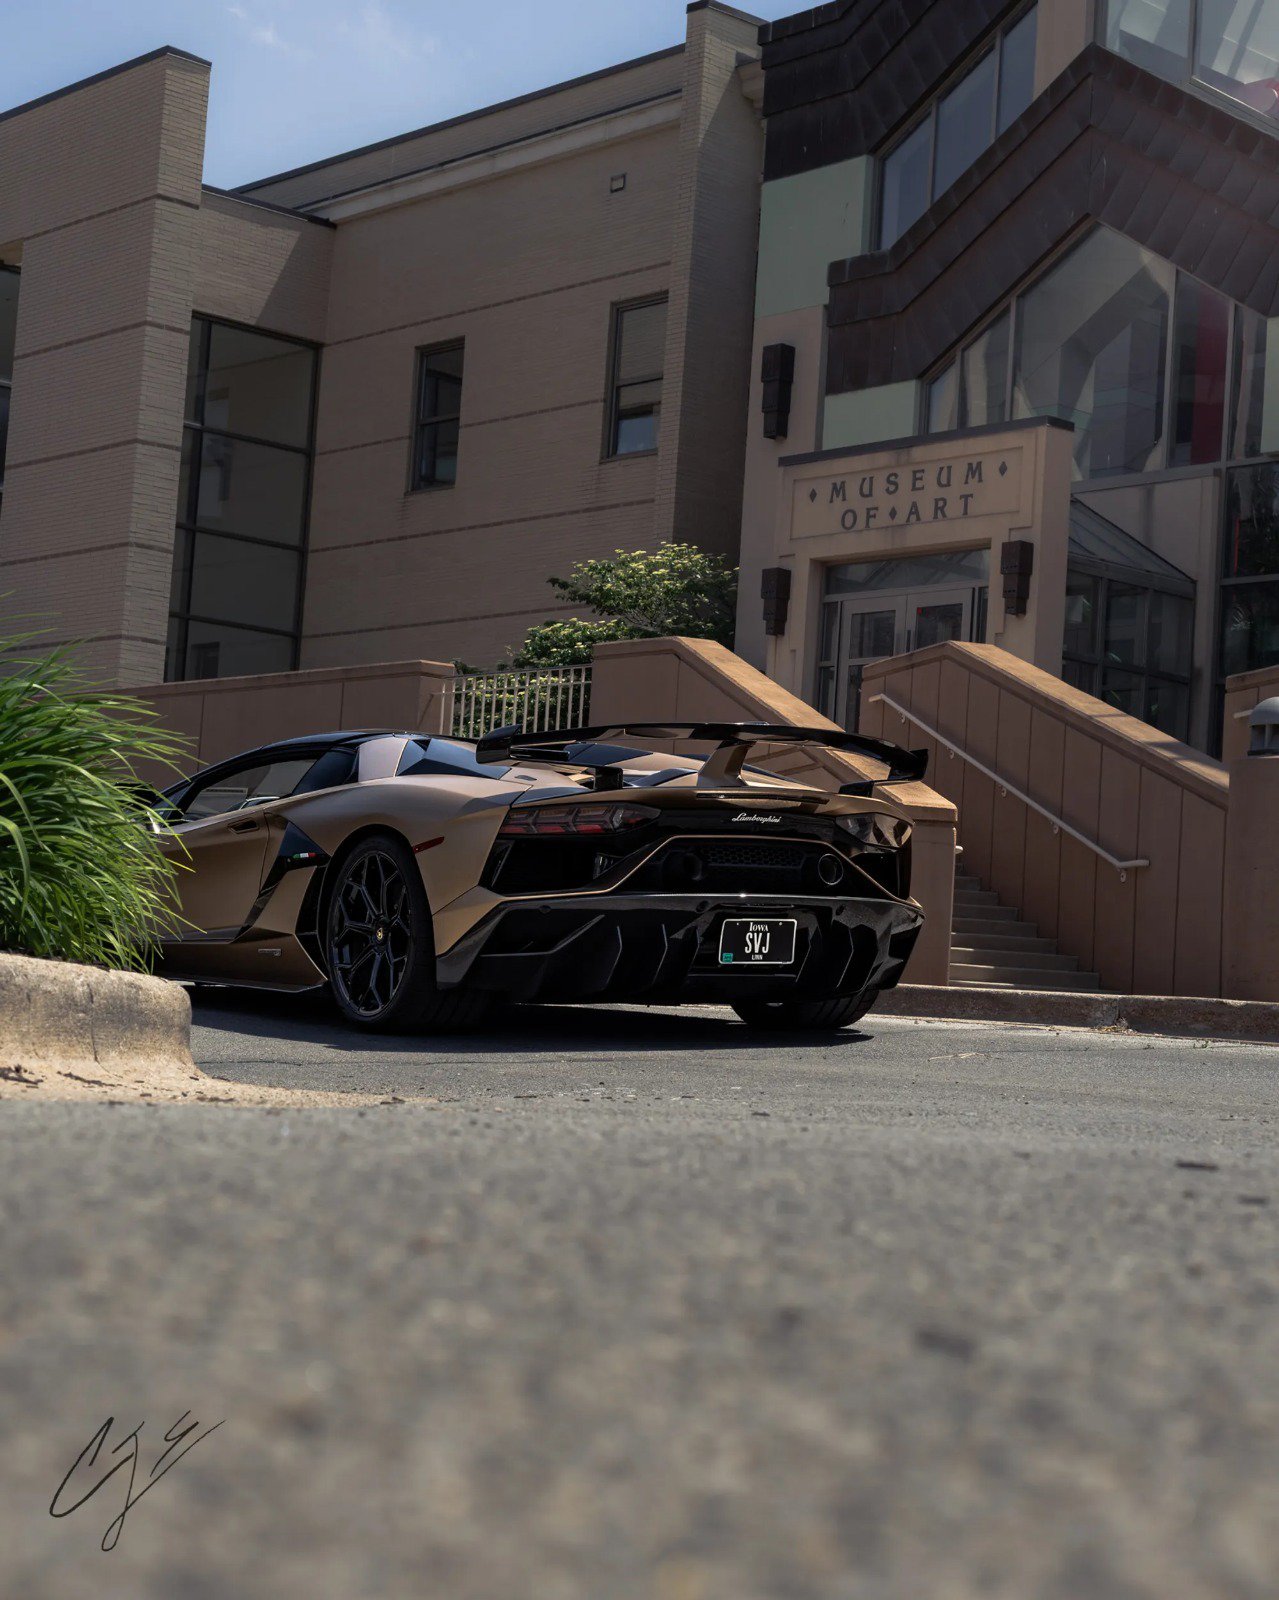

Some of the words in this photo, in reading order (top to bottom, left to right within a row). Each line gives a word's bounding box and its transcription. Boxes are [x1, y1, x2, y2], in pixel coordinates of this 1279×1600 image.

[829, 461, 983, 503] MUSEUM
[841, 507, 878, 530] OF
[905, 493, 973, 523] ART
[731, 812, 782, 823] Lamborghini
[744, 932, 770, 953] SVJ
